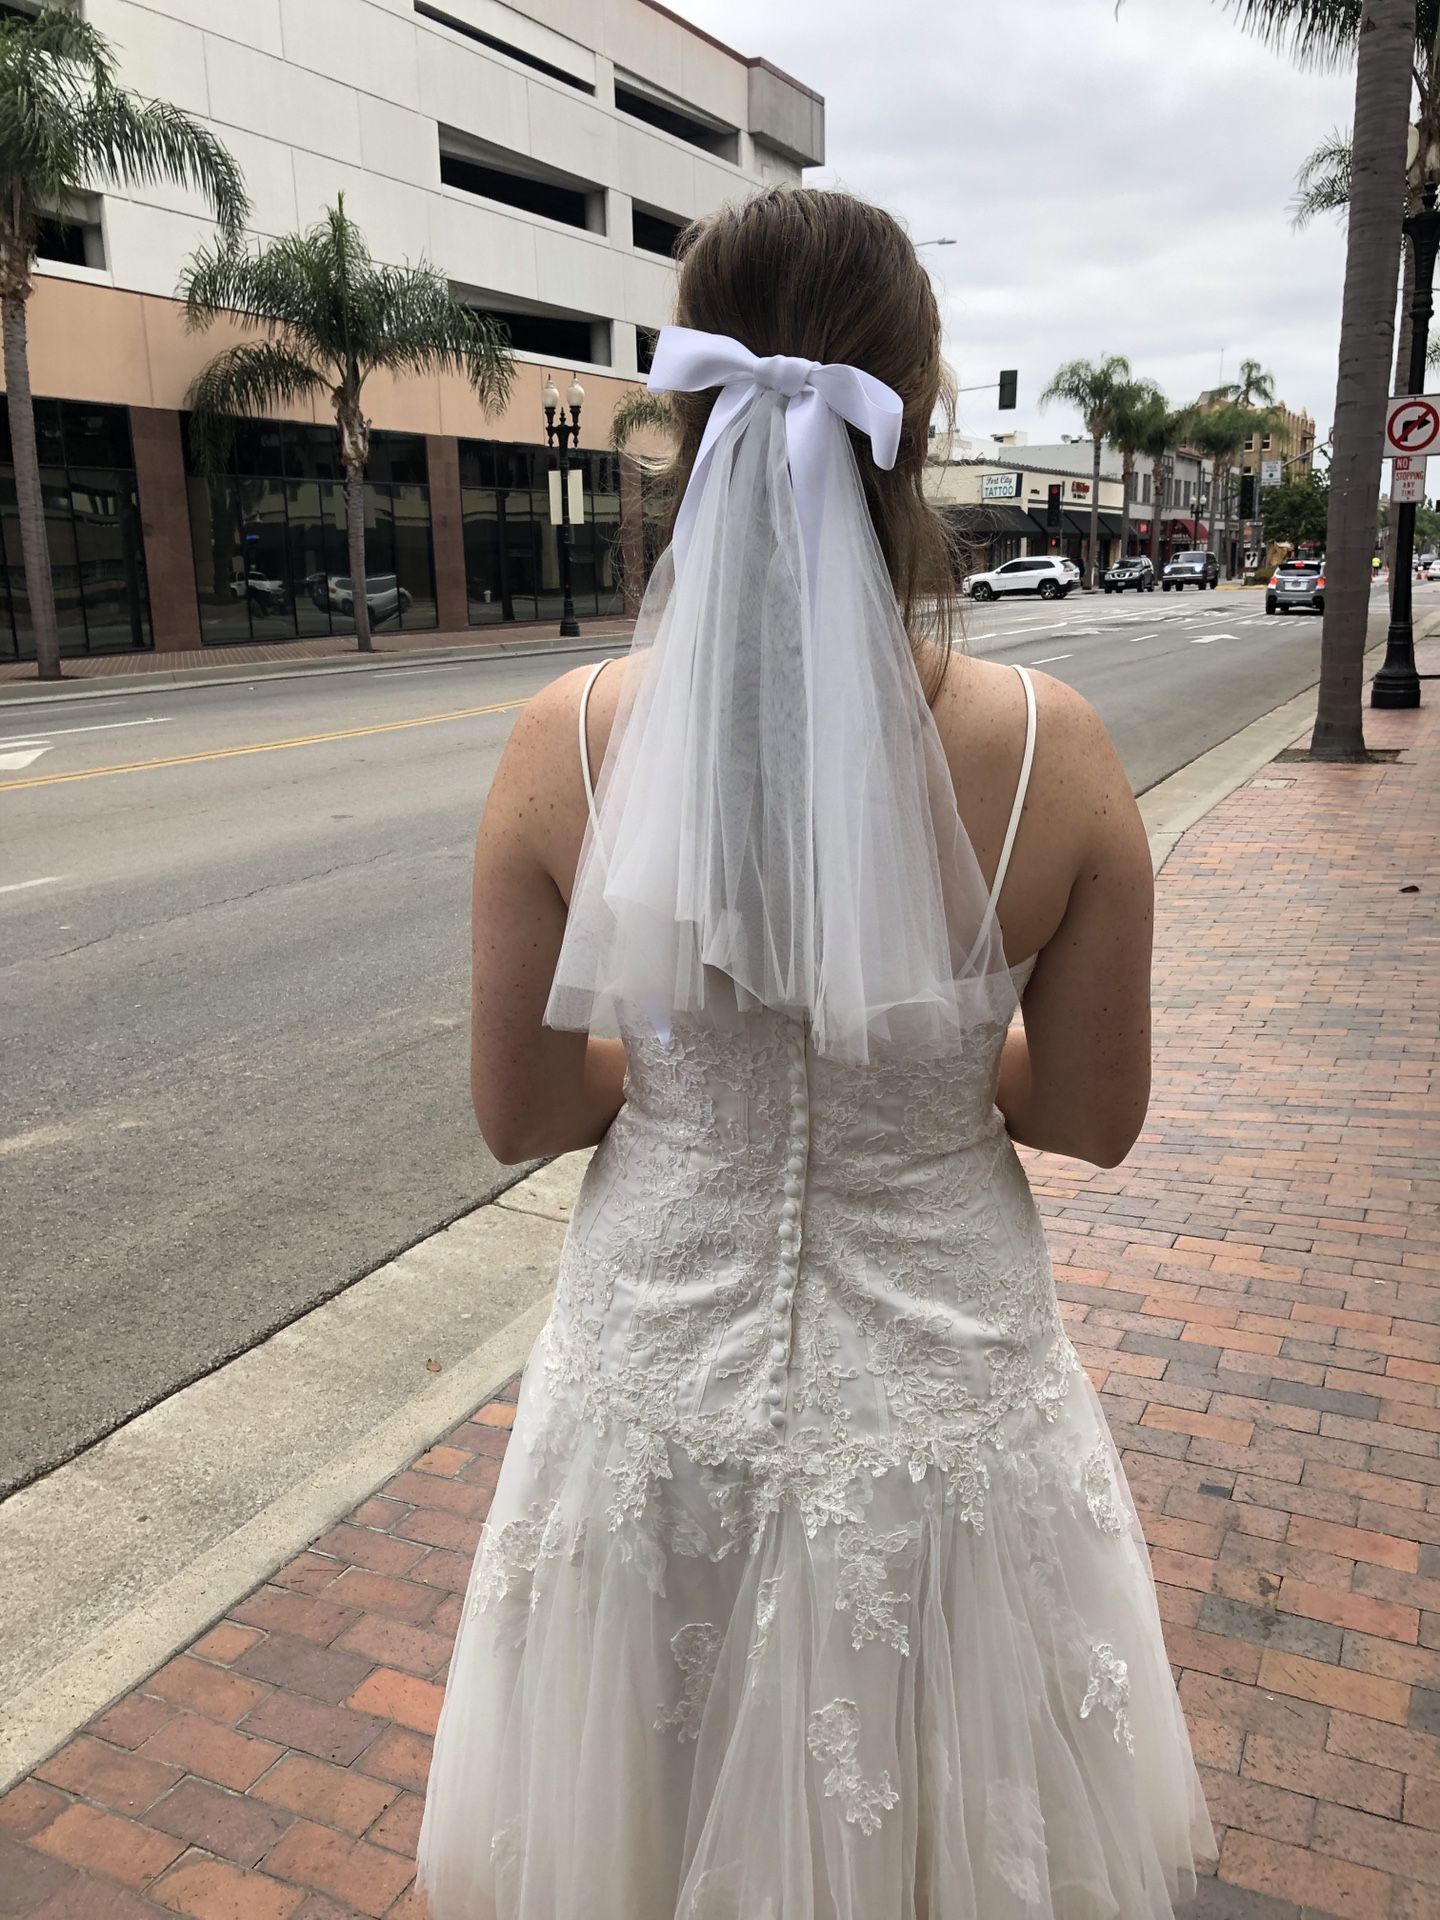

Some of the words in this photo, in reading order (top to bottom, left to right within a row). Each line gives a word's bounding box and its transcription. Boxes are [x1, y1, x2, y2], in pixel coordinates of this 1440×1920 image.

[1396, 457, 1408, 469] NO
[1000, 475, 1012, 485] City
[1396, 471, 1424, 480] STOPPING
[985, 485, 1013, 496] TATTOO
